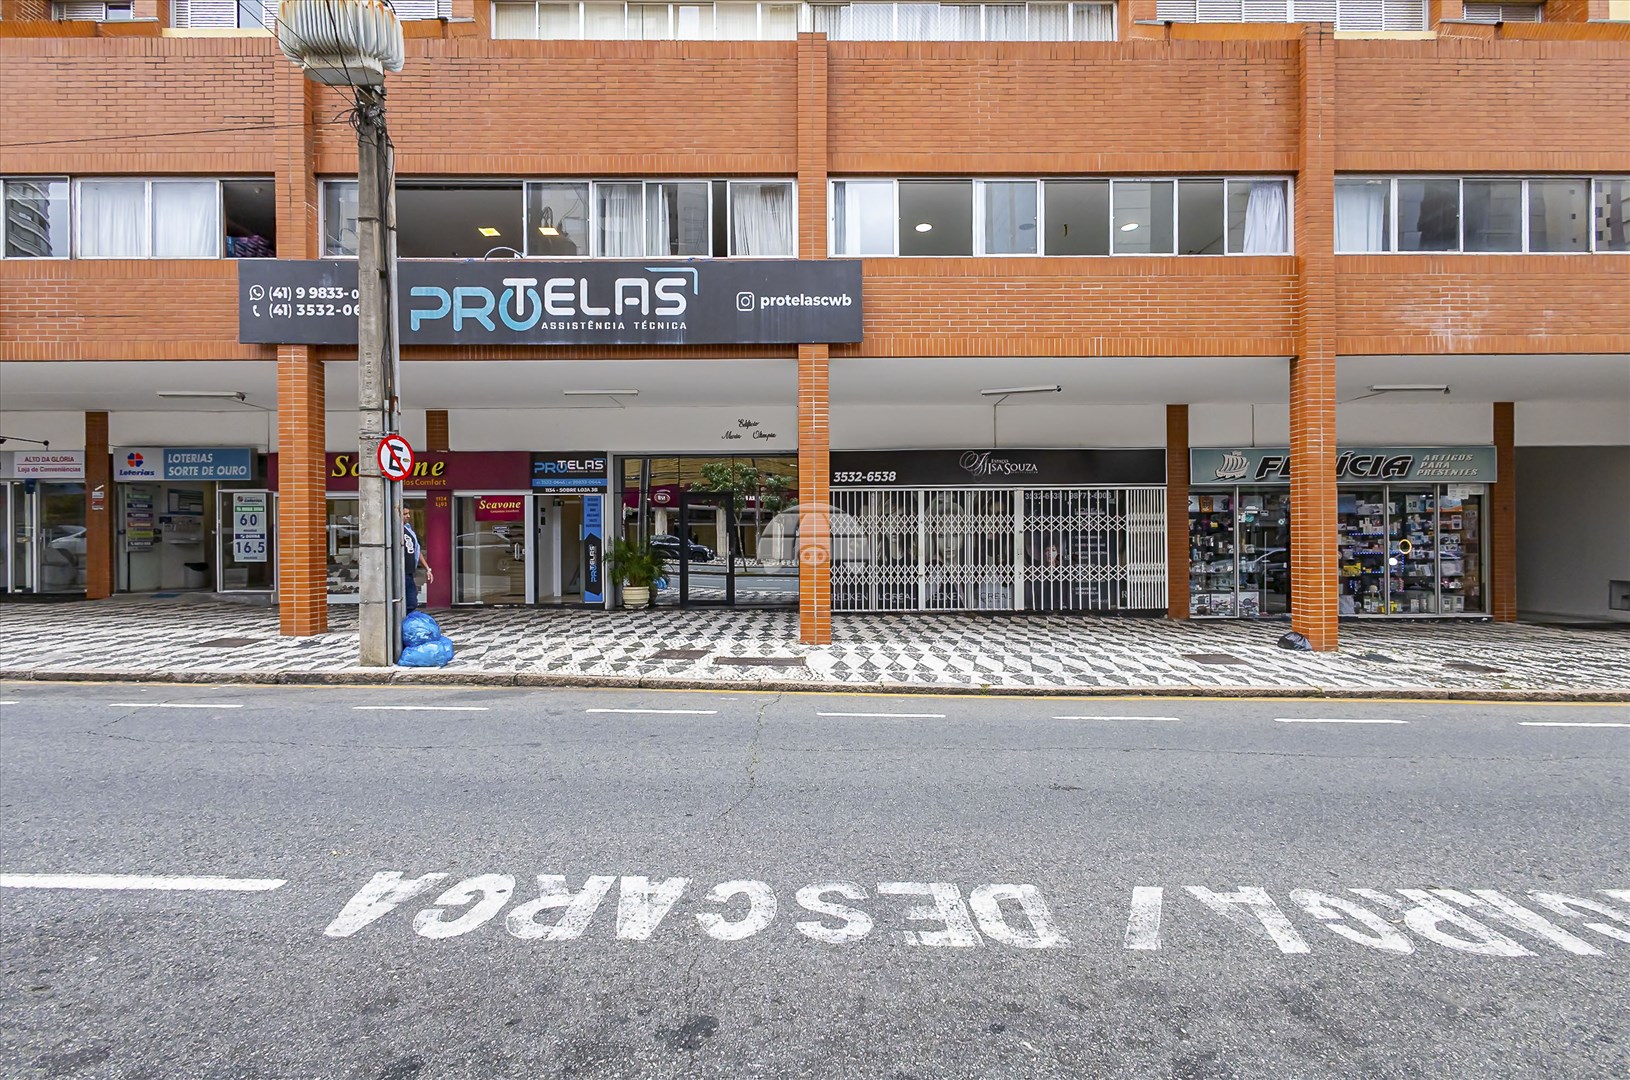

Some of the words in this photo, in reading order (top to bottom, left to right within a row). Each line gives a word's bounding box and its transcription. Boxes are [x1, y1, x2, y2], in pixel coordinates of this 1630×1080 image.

[269, 286, 292, 301] (41)
[296, 287, 305, 299] 9
[411, 278, 688, 332] PROTELAS
[760, 294, 852, 310] protelascwb
[269, 303, 292, 319] (41)
[296, 304, 360, 316] 3532-06
[541, 320, 625, 330] ASSISTÊNCIA
[634, 320, 688, 330] TÉCNICA
[168, 453, 213, 463] LOTERIAS
[168, 466, 199, 476] SORTE
[202, 466, 214, 476] DE
[217, 465, 247, 475] OURO
[331, 455, 445, 477] Scne
[534, 460, 604, 473] PROTELAS
[1004, 463, 1038, 475] SOUZA
[1254, 451, 1413, 480] FÍCIA
[833, 471, 897, 482] 3532-6538
[479, 500, 521, 509] Scavone
[240, 514, 258, 526] 60
[235, 541, 265, 554] 16.5
[324, 871, 1071, 948] DESCARGA
